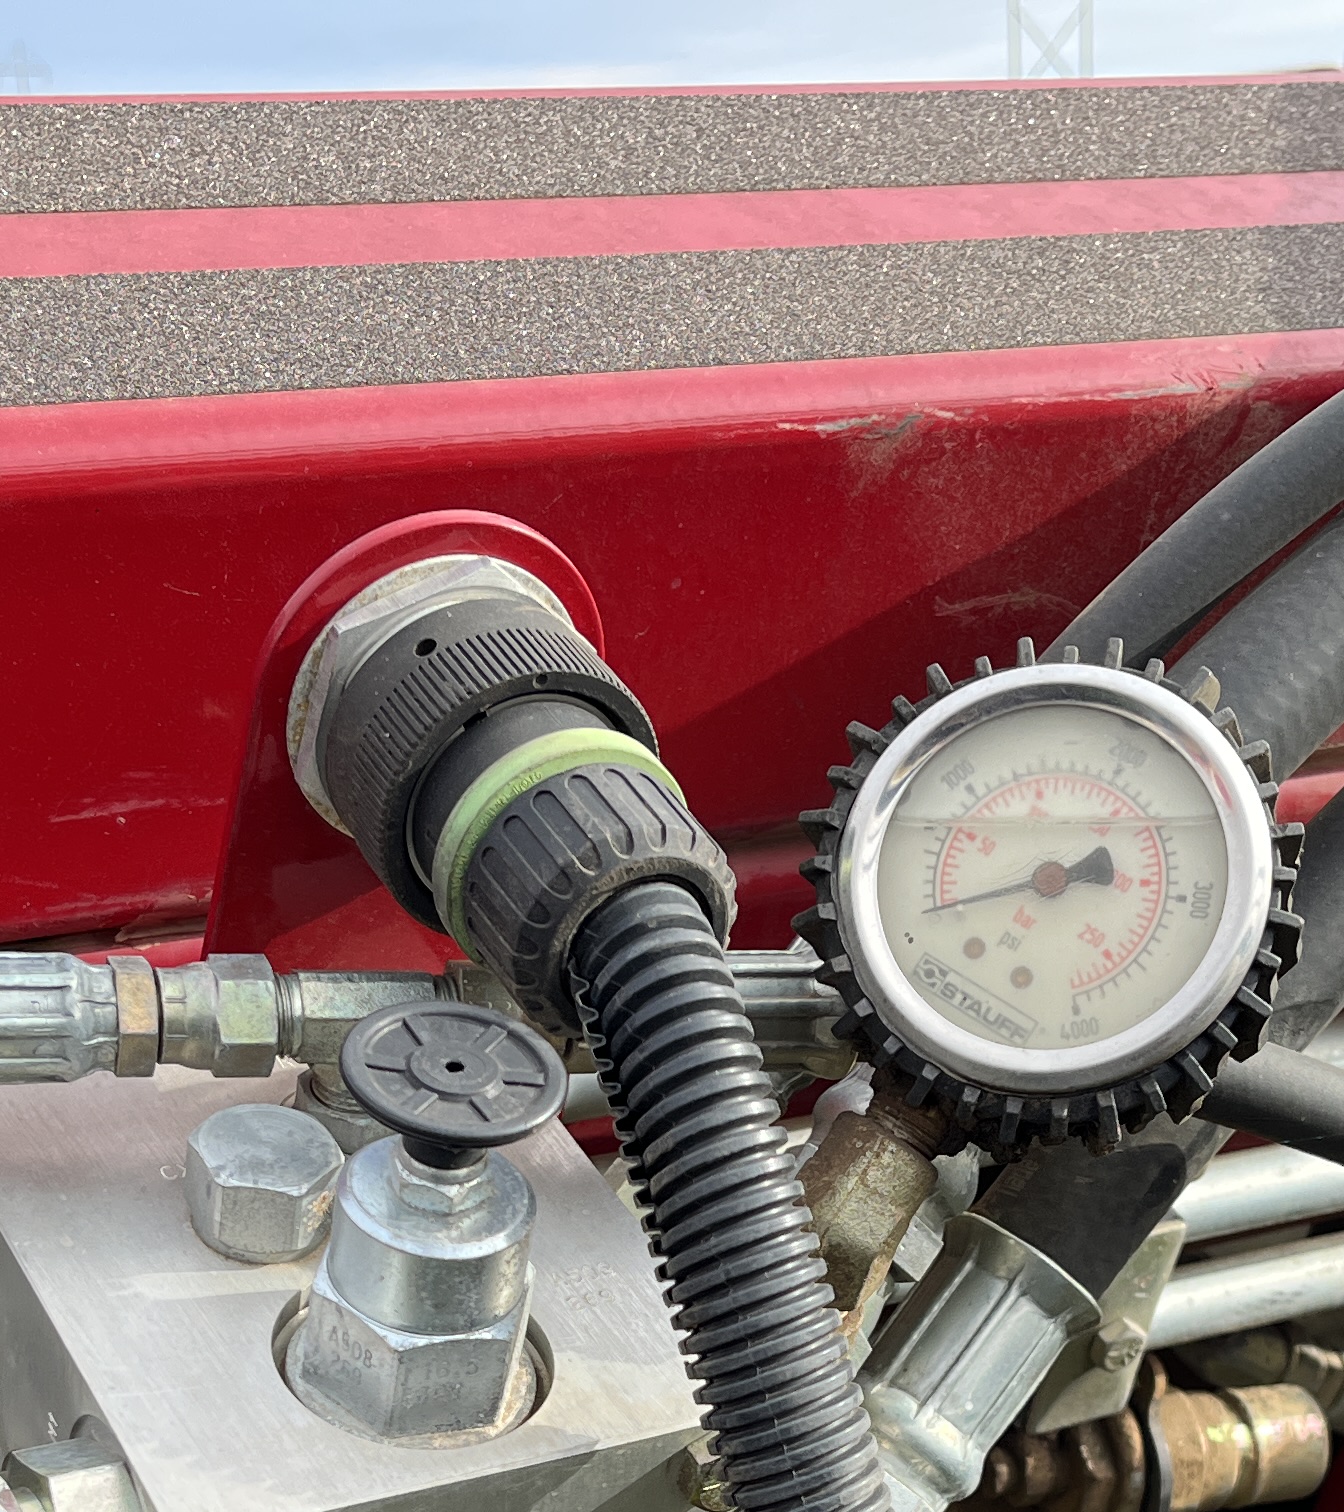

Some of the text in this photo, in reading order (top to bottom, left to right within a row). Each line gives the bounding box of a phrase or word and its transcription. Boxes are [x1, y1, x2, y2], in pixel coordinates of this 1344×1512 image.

[940, 758, 976, 790] 1000
[977, 835, 997, 857] 50
[1189, 880, 1214, 920] 3000
[1012, 904, 1038, 930] bar
[996, 930, 1024, 952] psi
[1077, 922, 1106, 949] 250
[940, 981, 1031, 1040] STAUFF
[1059, 1016, 1100, 1041] 4000
